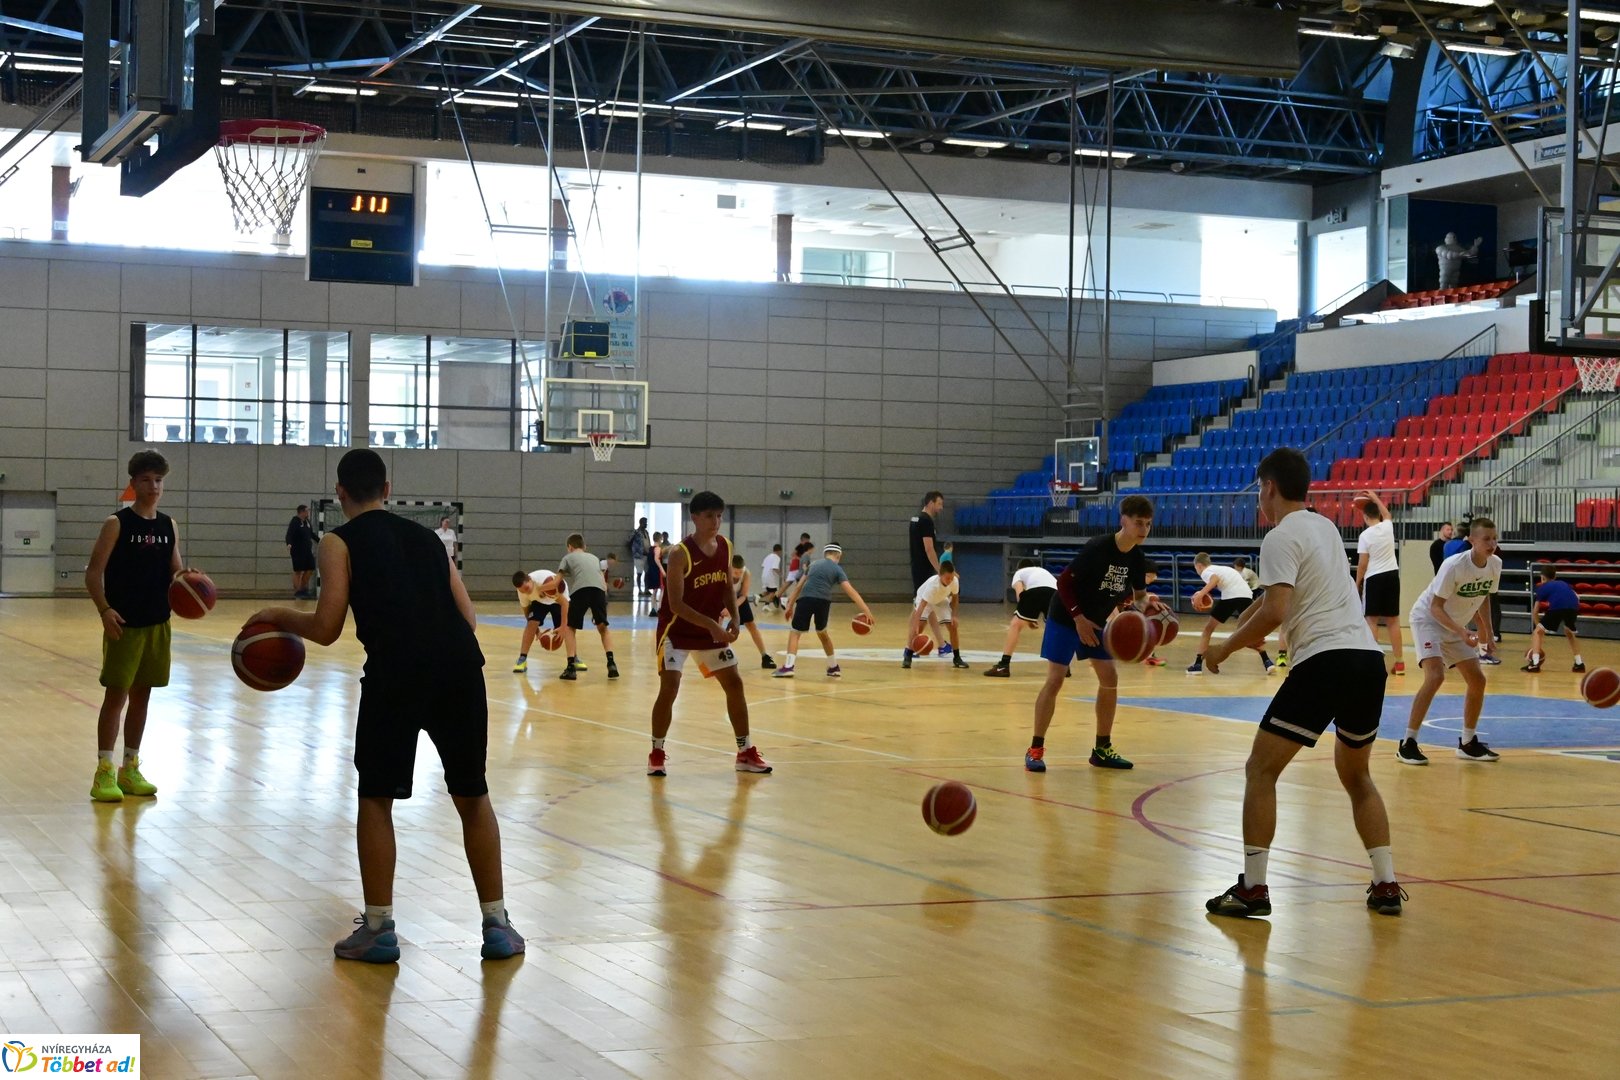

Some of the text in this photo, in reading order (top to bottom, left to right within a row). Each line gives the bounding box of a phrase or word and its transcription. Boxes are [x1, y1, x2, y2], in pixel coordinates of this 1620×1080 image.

[1109, 564, 1129, 575] BLOOD
[694, 569, 728, 589] ESPAÑA
[1459, 580, 1493, 592] CELTCS
